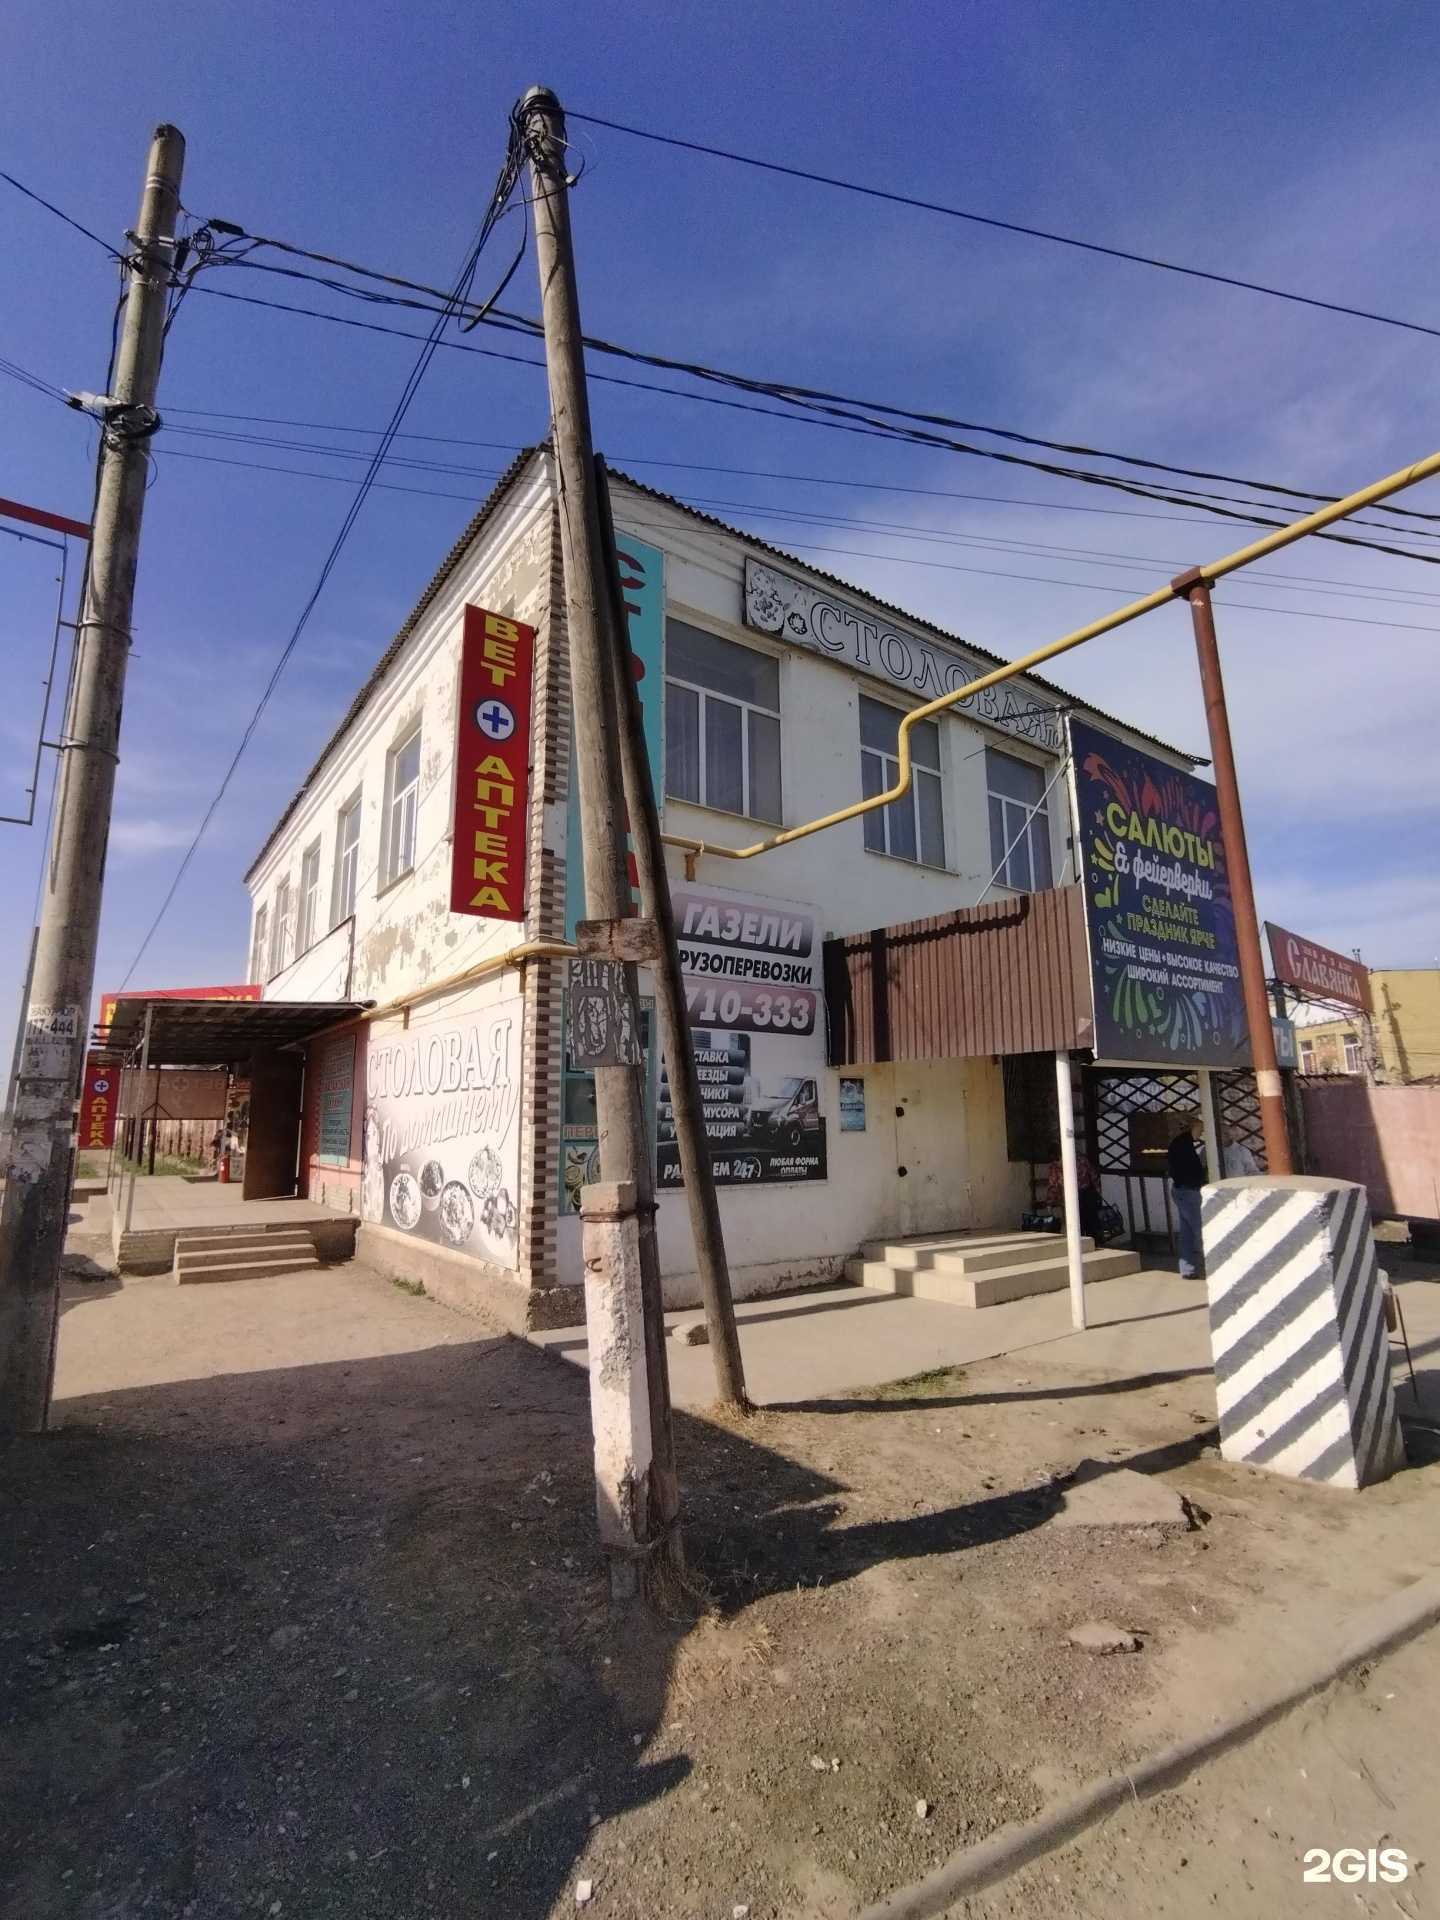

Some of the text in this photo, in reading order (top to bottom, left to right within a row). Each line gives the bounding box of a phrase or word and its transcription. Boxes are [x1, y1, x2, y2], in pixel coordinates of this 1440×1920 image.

[480, 614, 520, 687] ВЕТ
[810, 601, 1049, 747] СТОЛОВАЯ
[469, 754, 516, 912] АПТЕКА
[1105, 802, 1216, 870] САЛЮТЫ
[1132, 848, 1213, 901] фейерверки
[682, 902, 803, 951] ГАЗЕЛИ
[1127, 912, 1216, 950] ПРАЗДНИК ЯРЧЕ
[1142, 894, 1199, 925] СДЕЛАЙТЕ
[680, 950, 813, 985] РУЗОПЕРЕВОЗКИ
[1102, 937, 1239, 978] НИЗКИЕ ЦЕНЫ ВЫСОКОЕ КАЧЕСТВО
[1127, 964, 1224, 993] ШИРОКИЙ АССОРТИМЕНТ
[367, 1018, 512, 1100] СТОЛОВАЯ
[88, 1097, 109, 1147] АПТЕКА
[770, 1156, 819, 1167] ЛЮБАЯ ФОРМА
